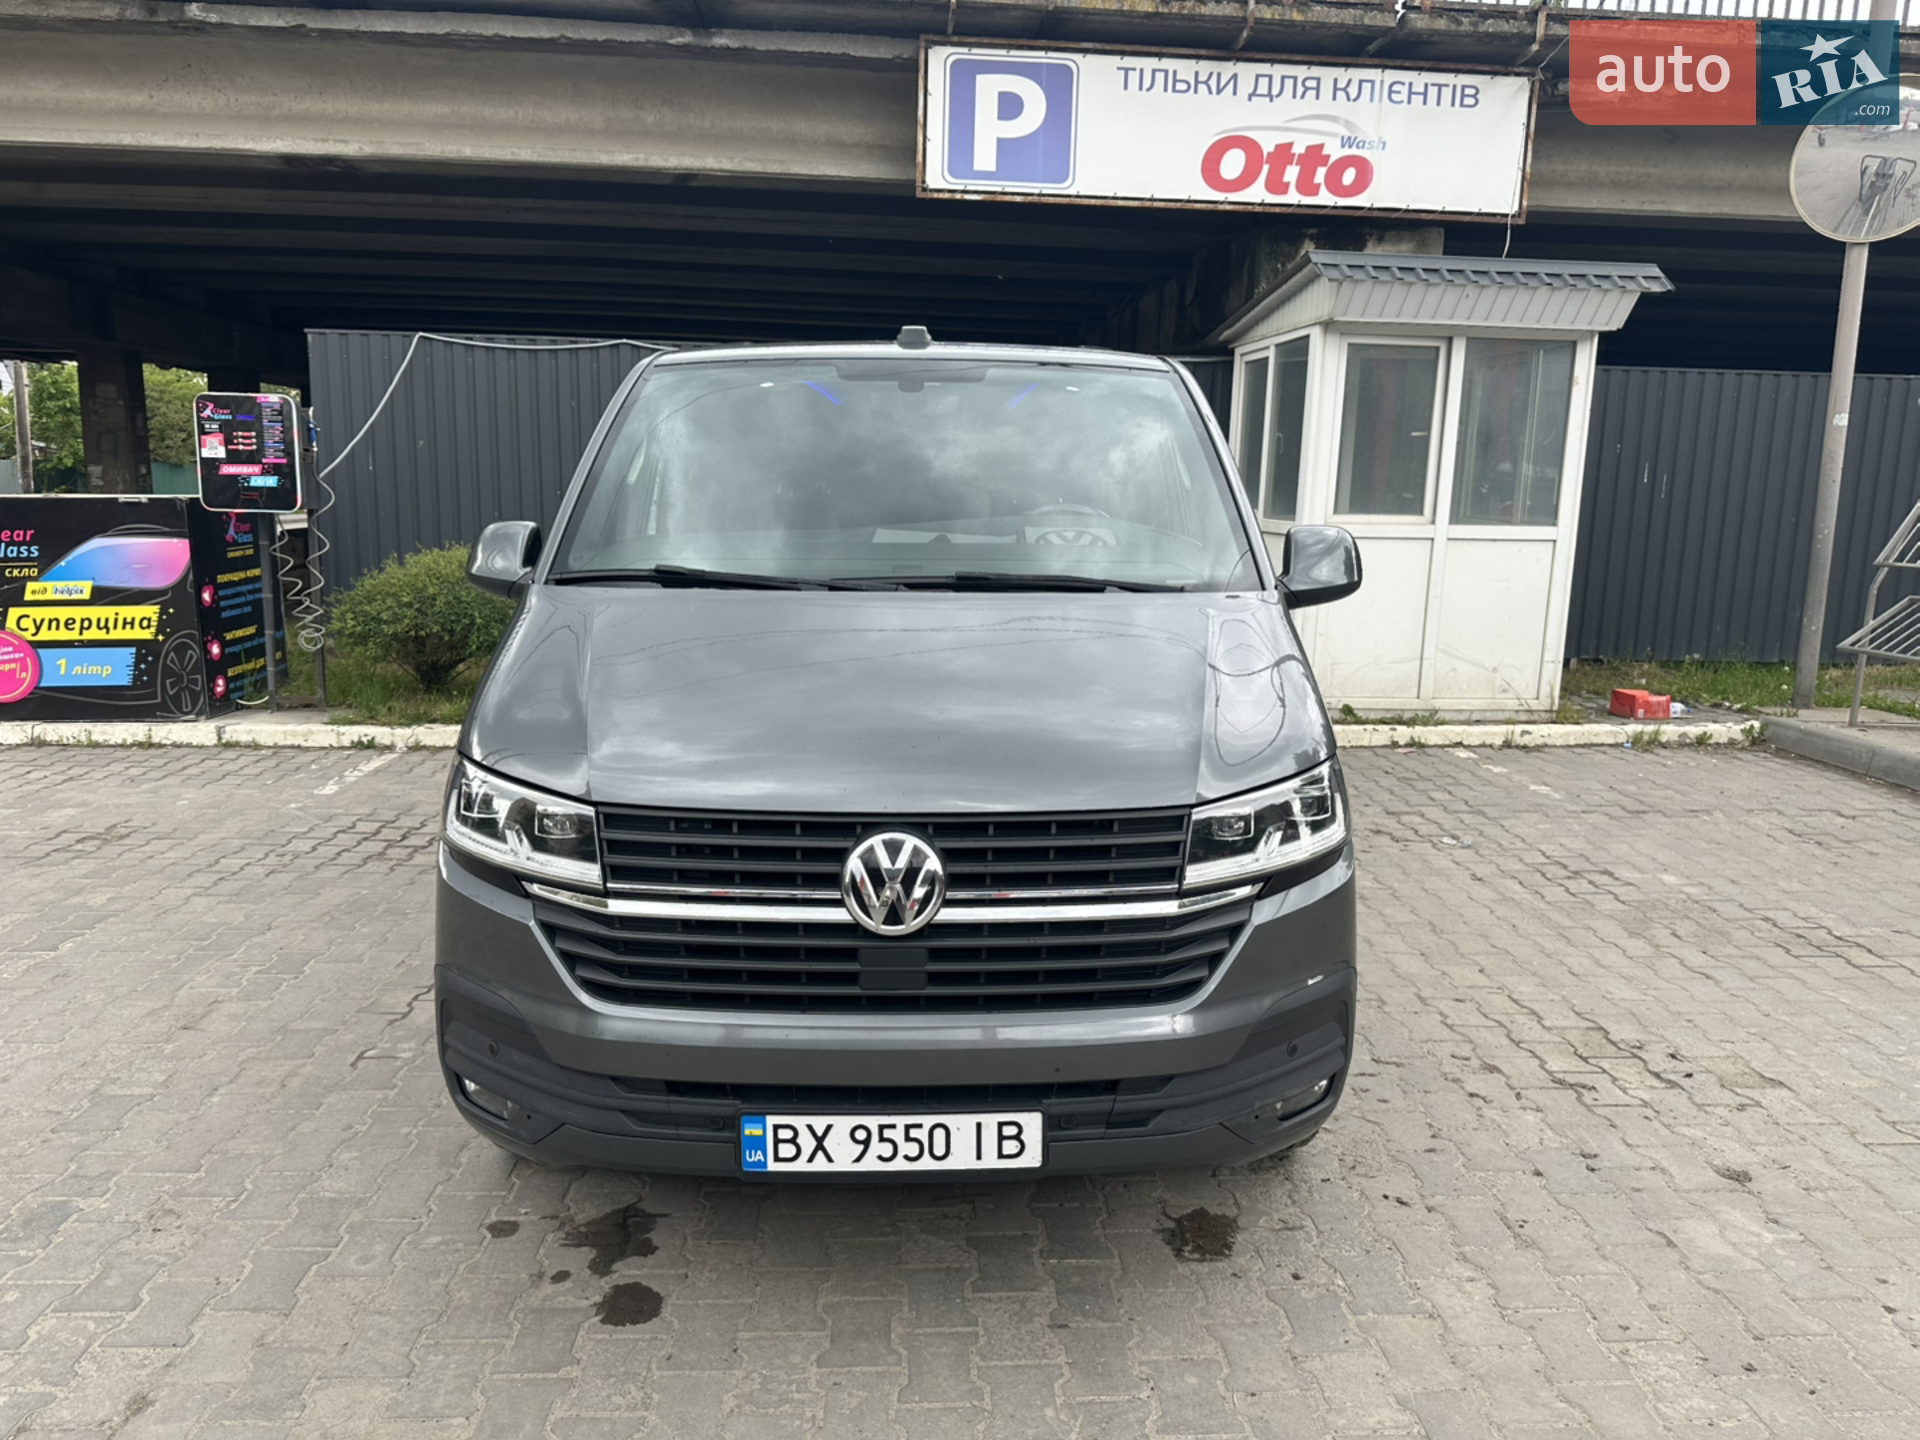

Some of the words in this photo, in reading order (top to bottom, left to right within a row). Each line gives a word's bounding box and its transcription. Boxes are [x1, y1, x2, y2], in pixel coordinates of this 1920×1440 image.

[1116, 66, 1239, 97] ТІЛЬКИ
[1247, 73, 1322, 103] ДЛЯ
[1331, 77, 1481, 109] КЛІЄНТІВ
[973, 74, 1047, 172] P
[1339, 135, 1387, 151] Wash
[1200, 134, 1374, 198] Otto
[222, 465, 260, 474] ОМИВАЧ
[0, 529, 35, 542] ear
[5, 567, 38, 577] скла
[16, 611, 152, 636] Суперціна
[56, 658, 67, 675] 1
[72, 663, 112, 678] літр
[772, 1123, 835, 1164] BX
[849, 1122, 952, 1163] 9550
[975, 1120, 1026, 1160] IB
[745, 1150, 765, 1162] UA
